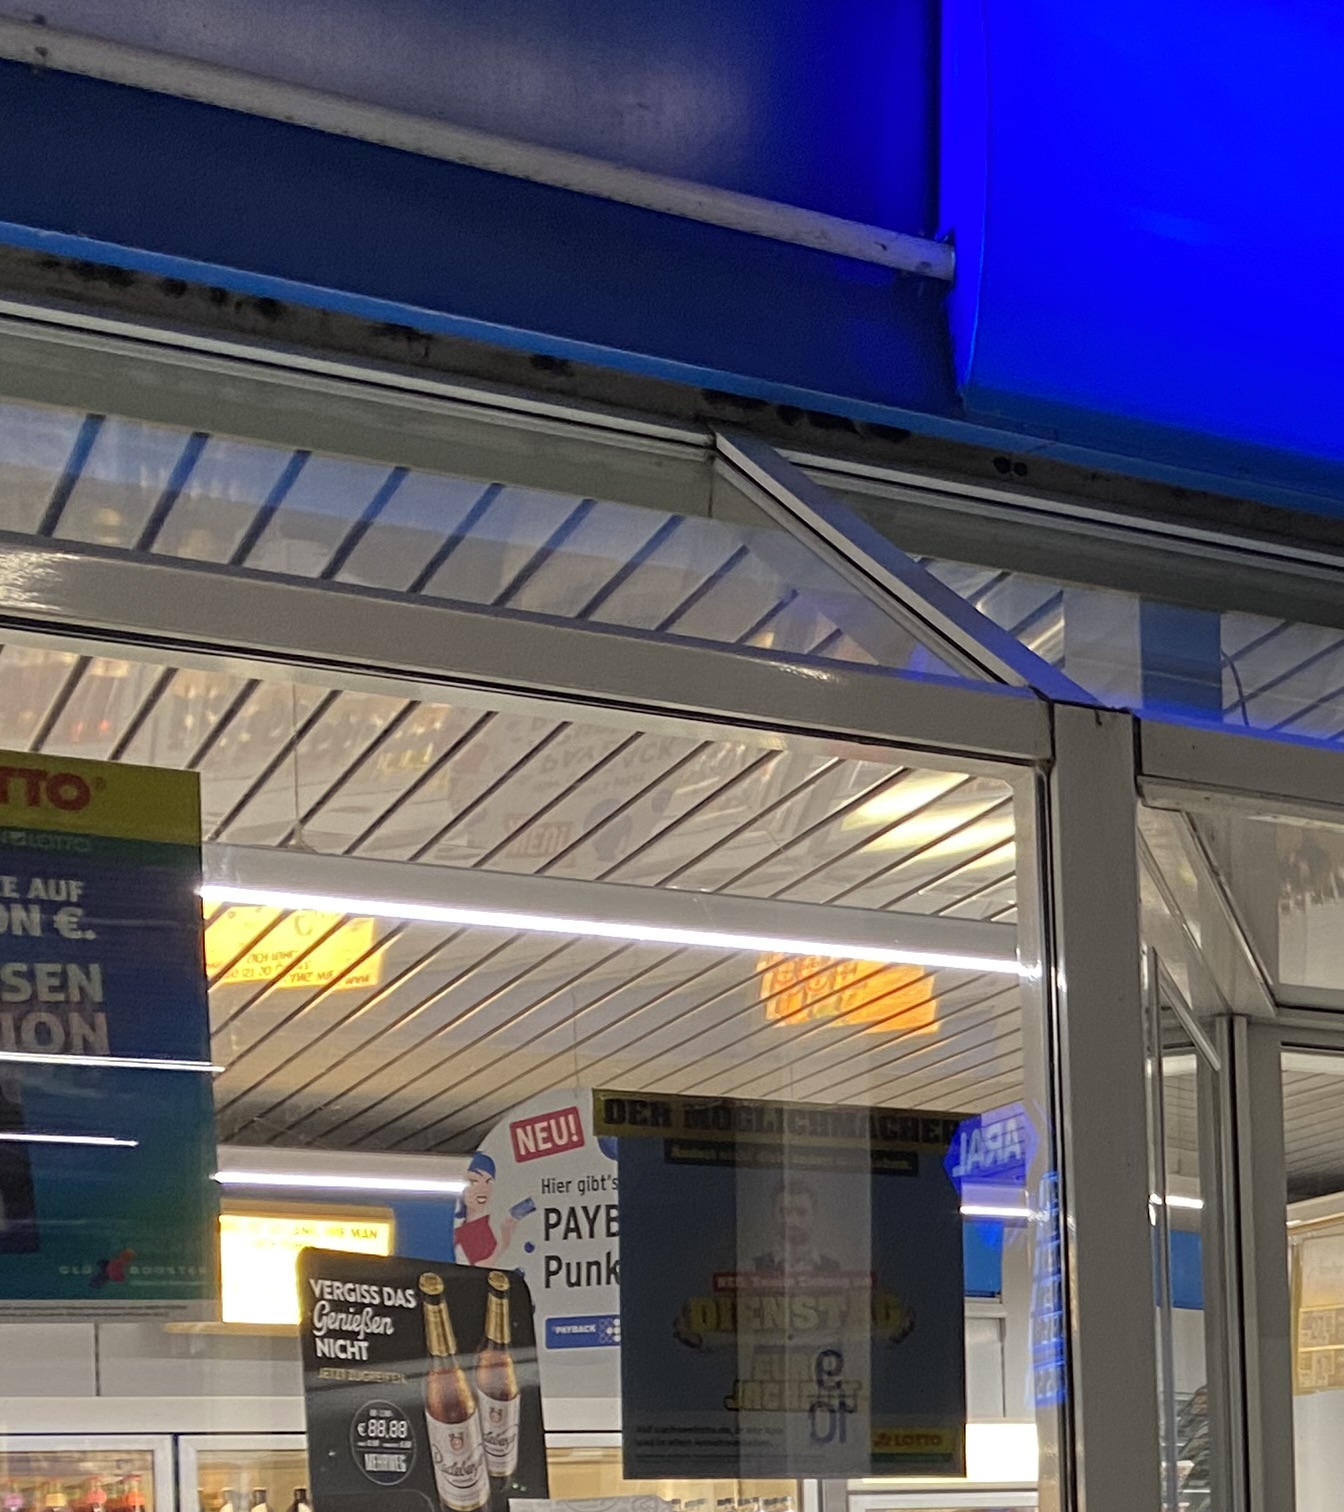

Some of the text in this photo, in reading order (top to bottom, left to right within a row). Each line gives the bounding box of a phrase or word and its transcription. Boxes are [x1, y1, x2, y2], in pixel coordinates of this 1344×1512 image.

[28, 879, 84, 902] AUF
[0, 963, 103, 1003] SEN
[516, 1115, 578, 1156] NEU!
[541, 1175, 619, 1197] Hier gibt's
[309, 1278, 417, 1308] VERGISS DAS
[313, 1300, 394, 1336] Genießen
[555, 1323, 597, 1335] PAYBACK
[315, 1338, 369, 1361] NICHT
